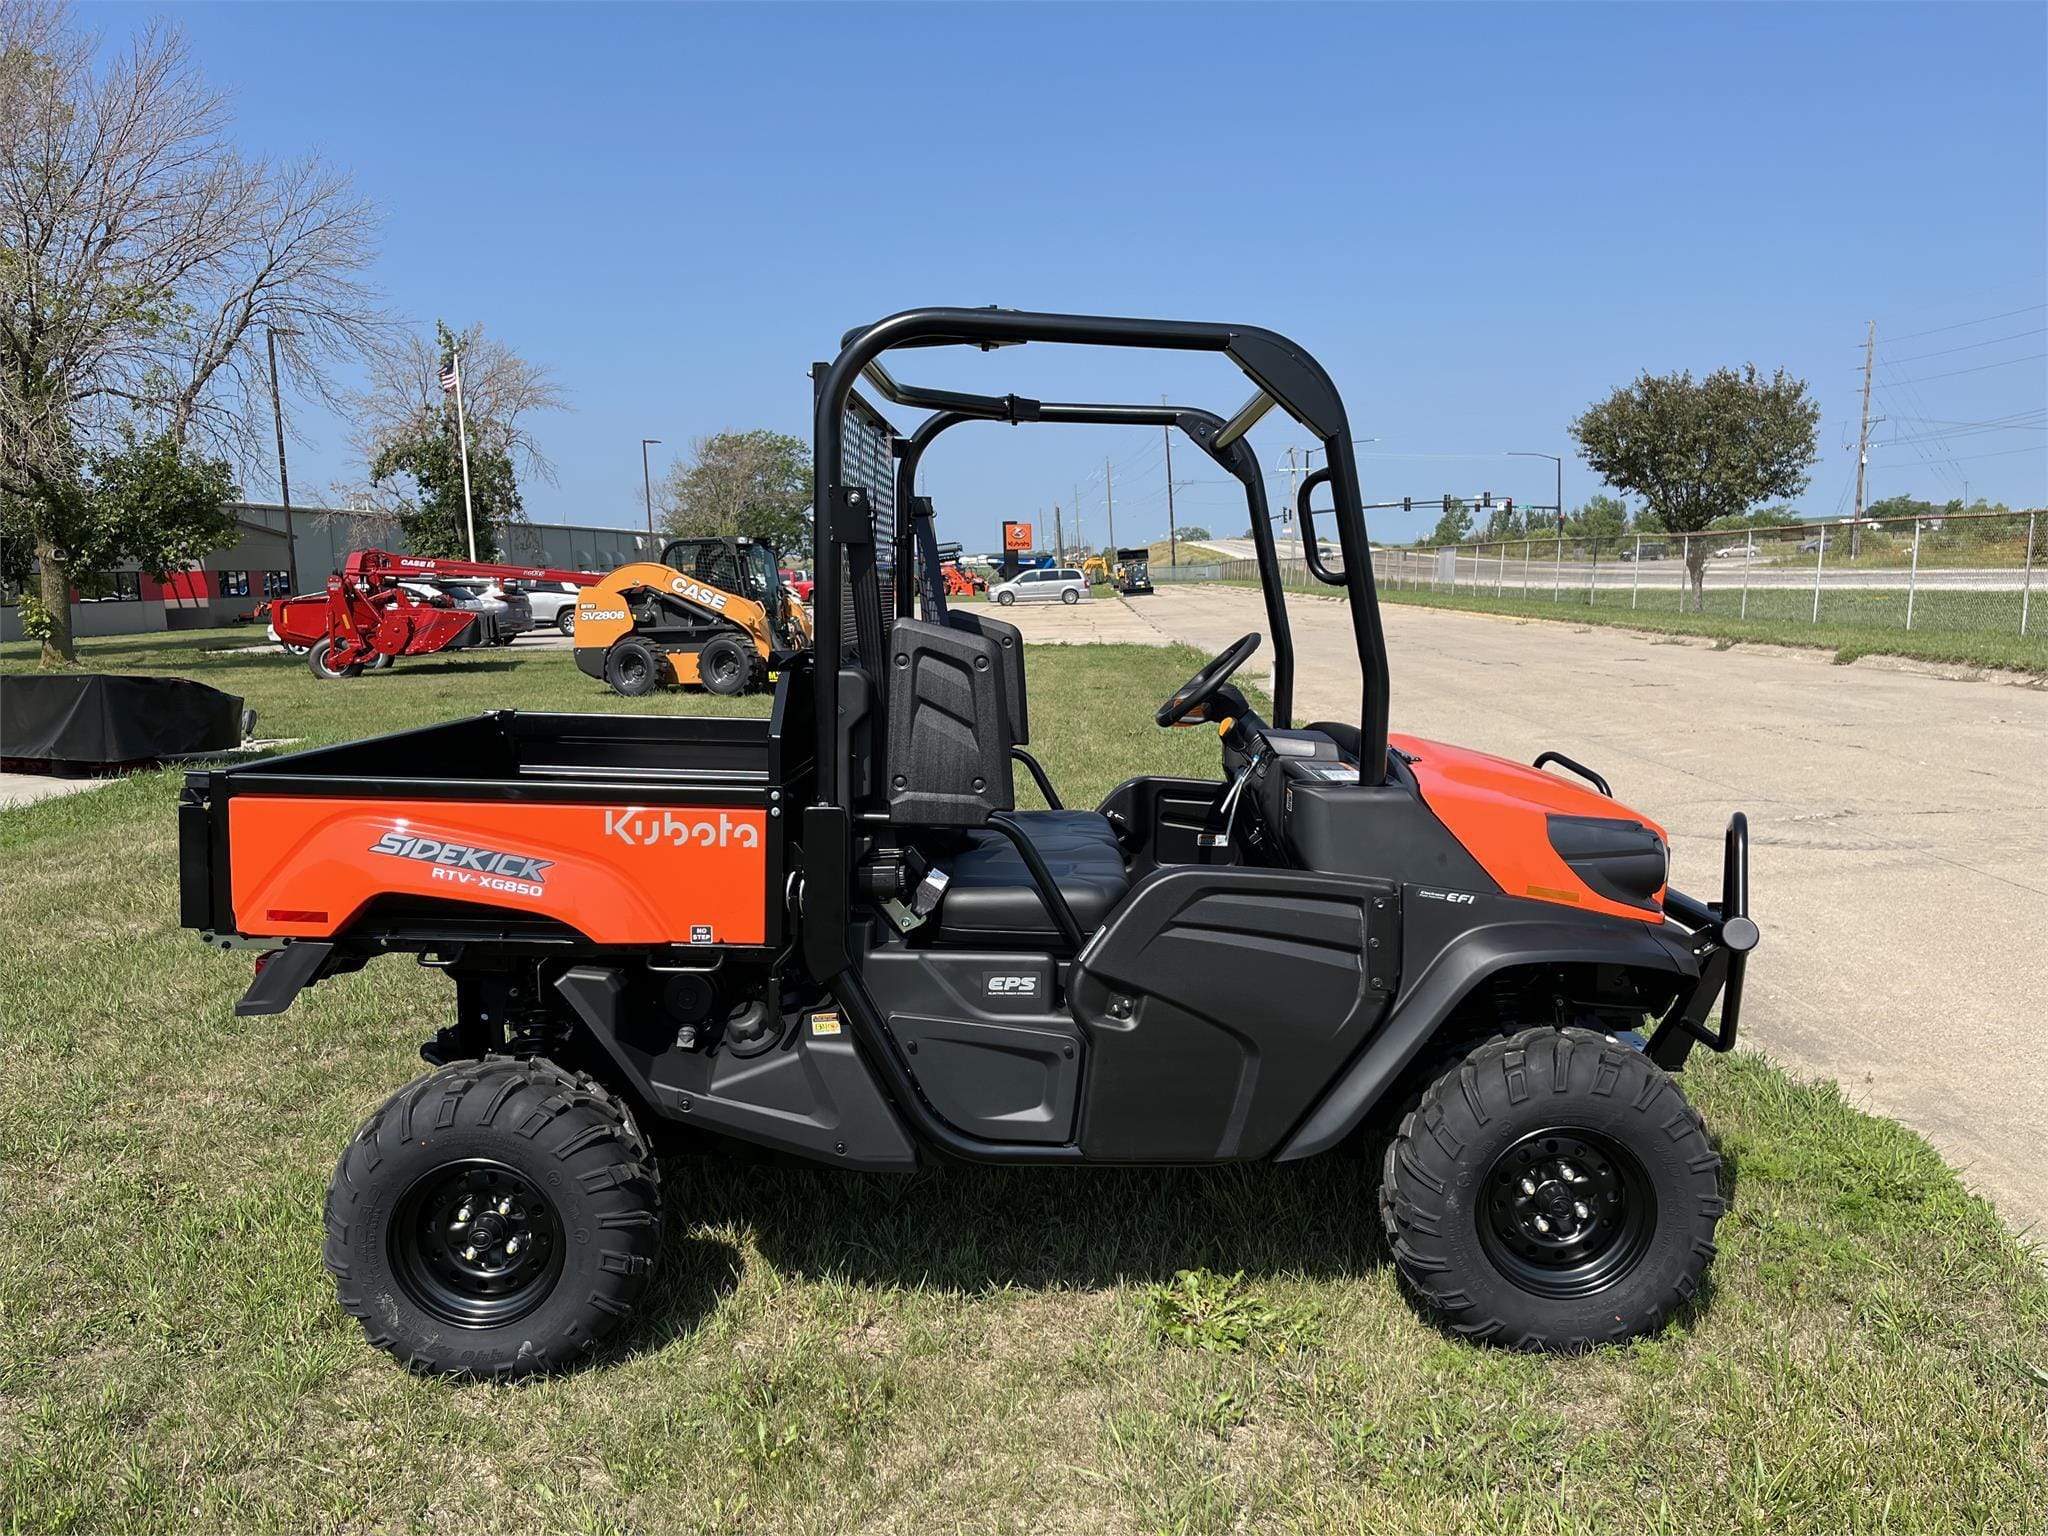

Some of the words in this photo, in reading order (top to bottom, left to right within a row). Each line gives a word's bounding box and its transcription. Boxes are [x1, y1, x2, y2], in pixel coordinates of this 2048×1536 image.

[400, 559, 427, 568] CASE
[671, 577, 728, 610] CASE
[581, 610, 625, 621] SV280B
[605, 805, 758, 848] Kubota
[368, 832, 556, 882] SIDEKICK
[1446, 893, 1475, 904] EFI
[988, 977, 1037, 990] EPS
